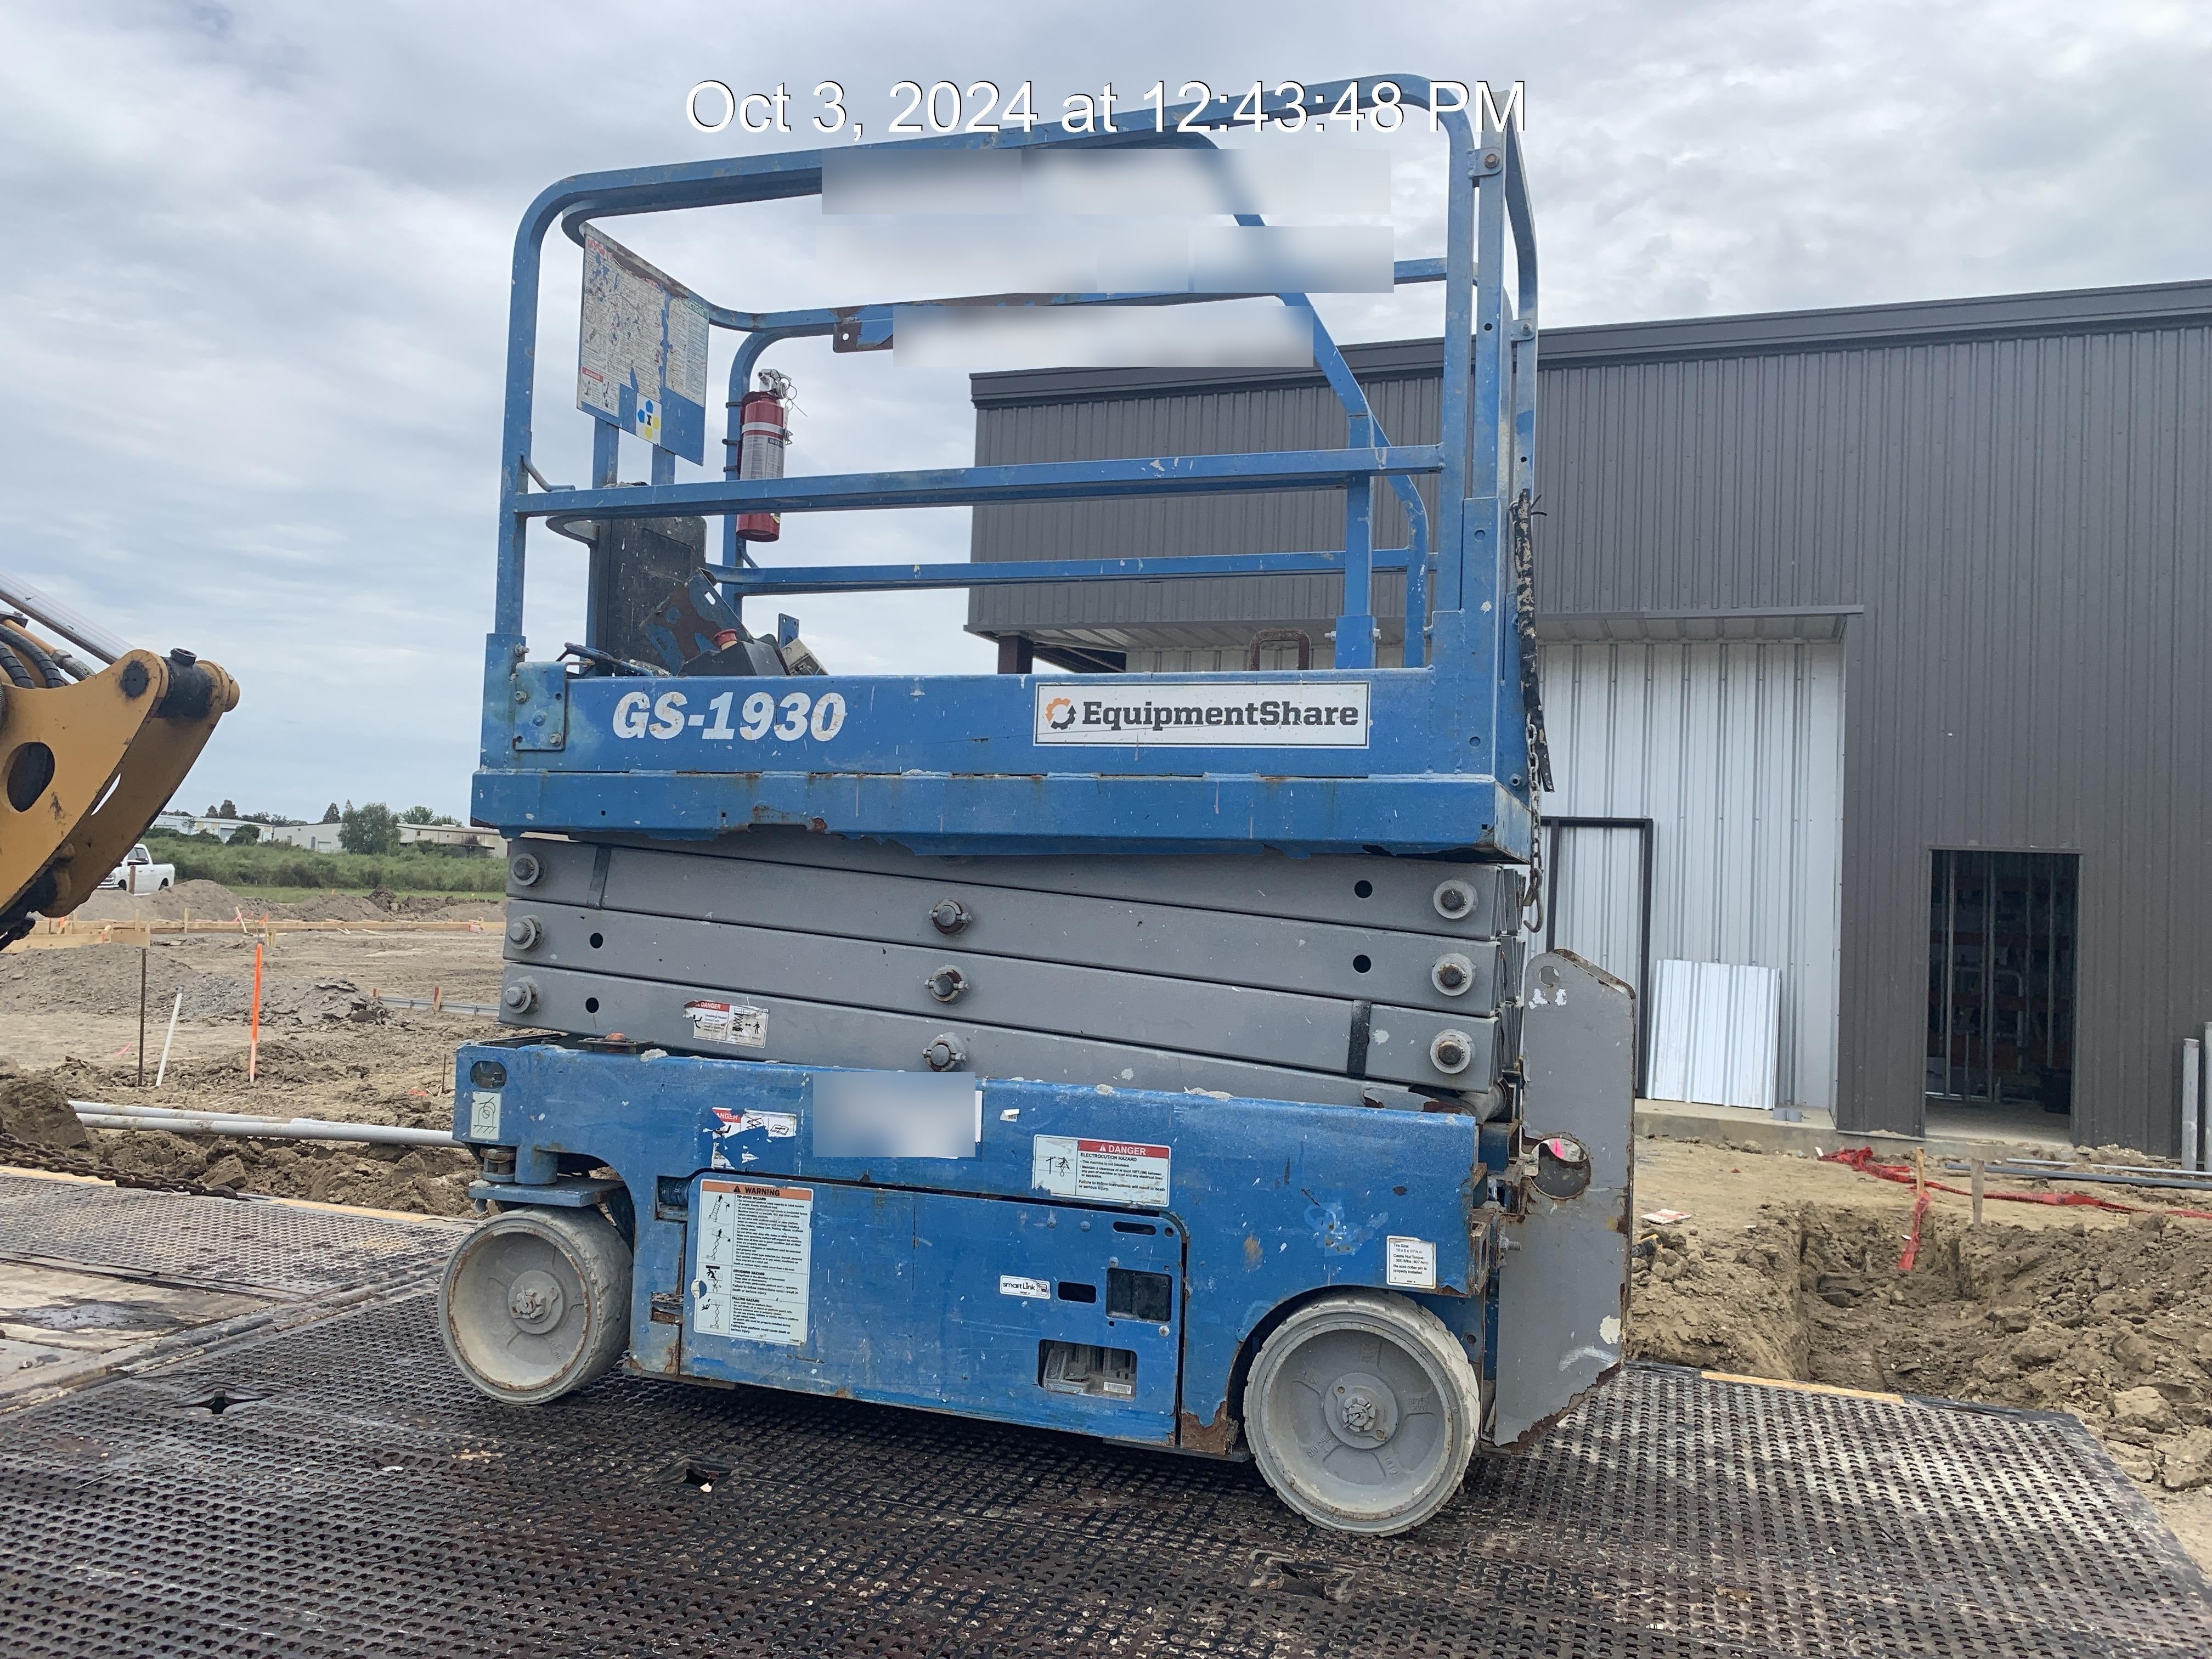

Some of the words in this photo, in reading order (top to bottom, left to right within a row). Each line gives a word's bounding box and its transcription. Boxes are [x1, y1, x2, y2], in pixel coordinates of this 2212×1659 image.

[613, 691, 846, 742] GS-1930
[1082, 701, 1358, 731] EquipmentShare
[701, 1002, 721, 1010] DANGER
[1108, 1145, 1146, 1155] DANGER
[745, 1186, 780, 1196] WARNING
